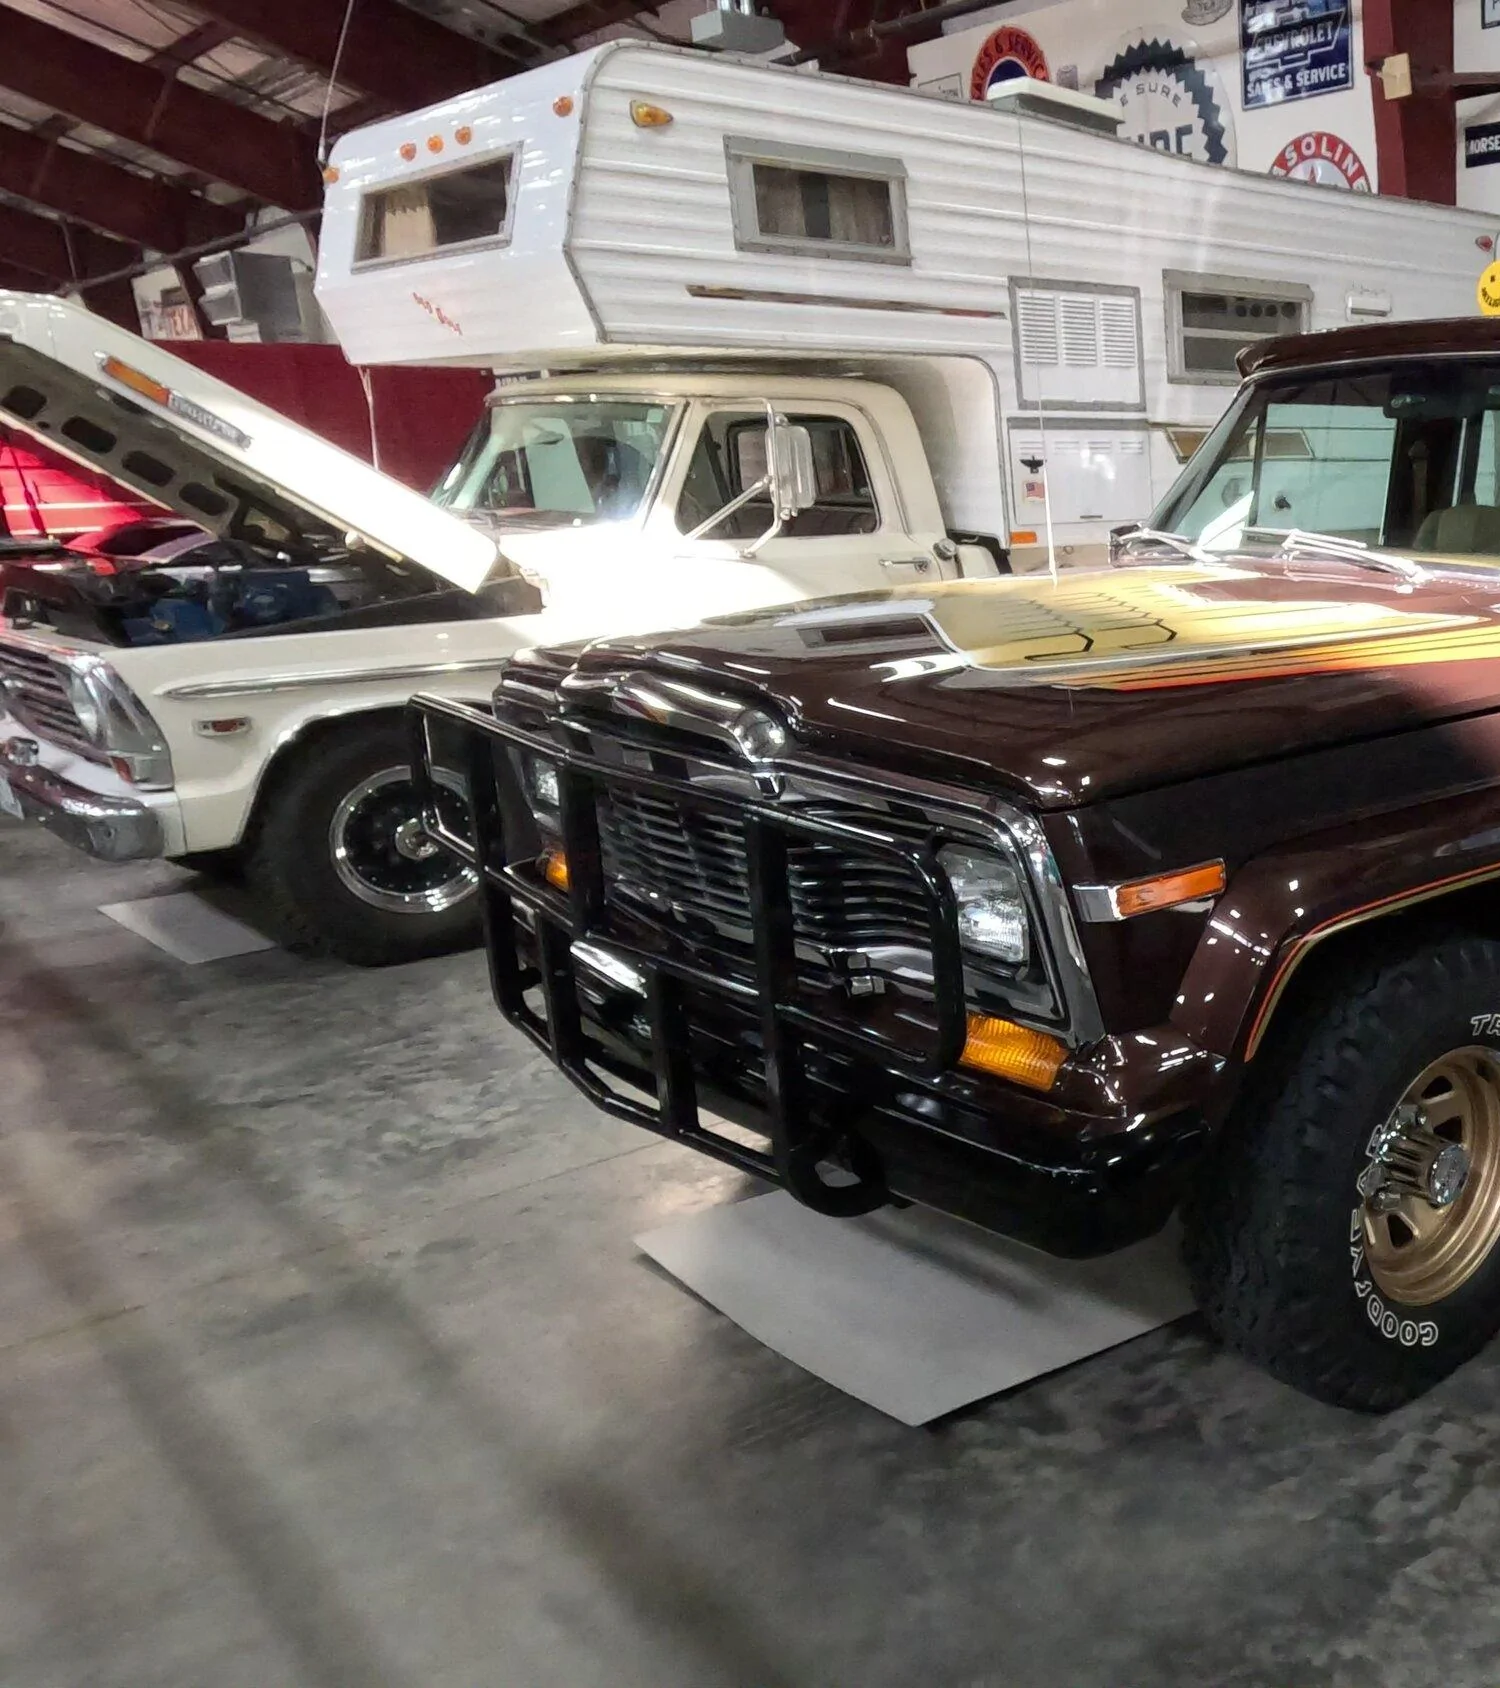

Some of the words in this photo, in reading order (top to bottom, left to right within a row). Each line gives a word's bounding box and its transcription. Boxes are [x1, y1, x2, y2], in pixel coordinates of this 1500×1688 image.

[1284, 74, 1294, 90] &
[1296, 62, 1346, 87] SERVICE
[1136, 82, 1182, 108] SURE
